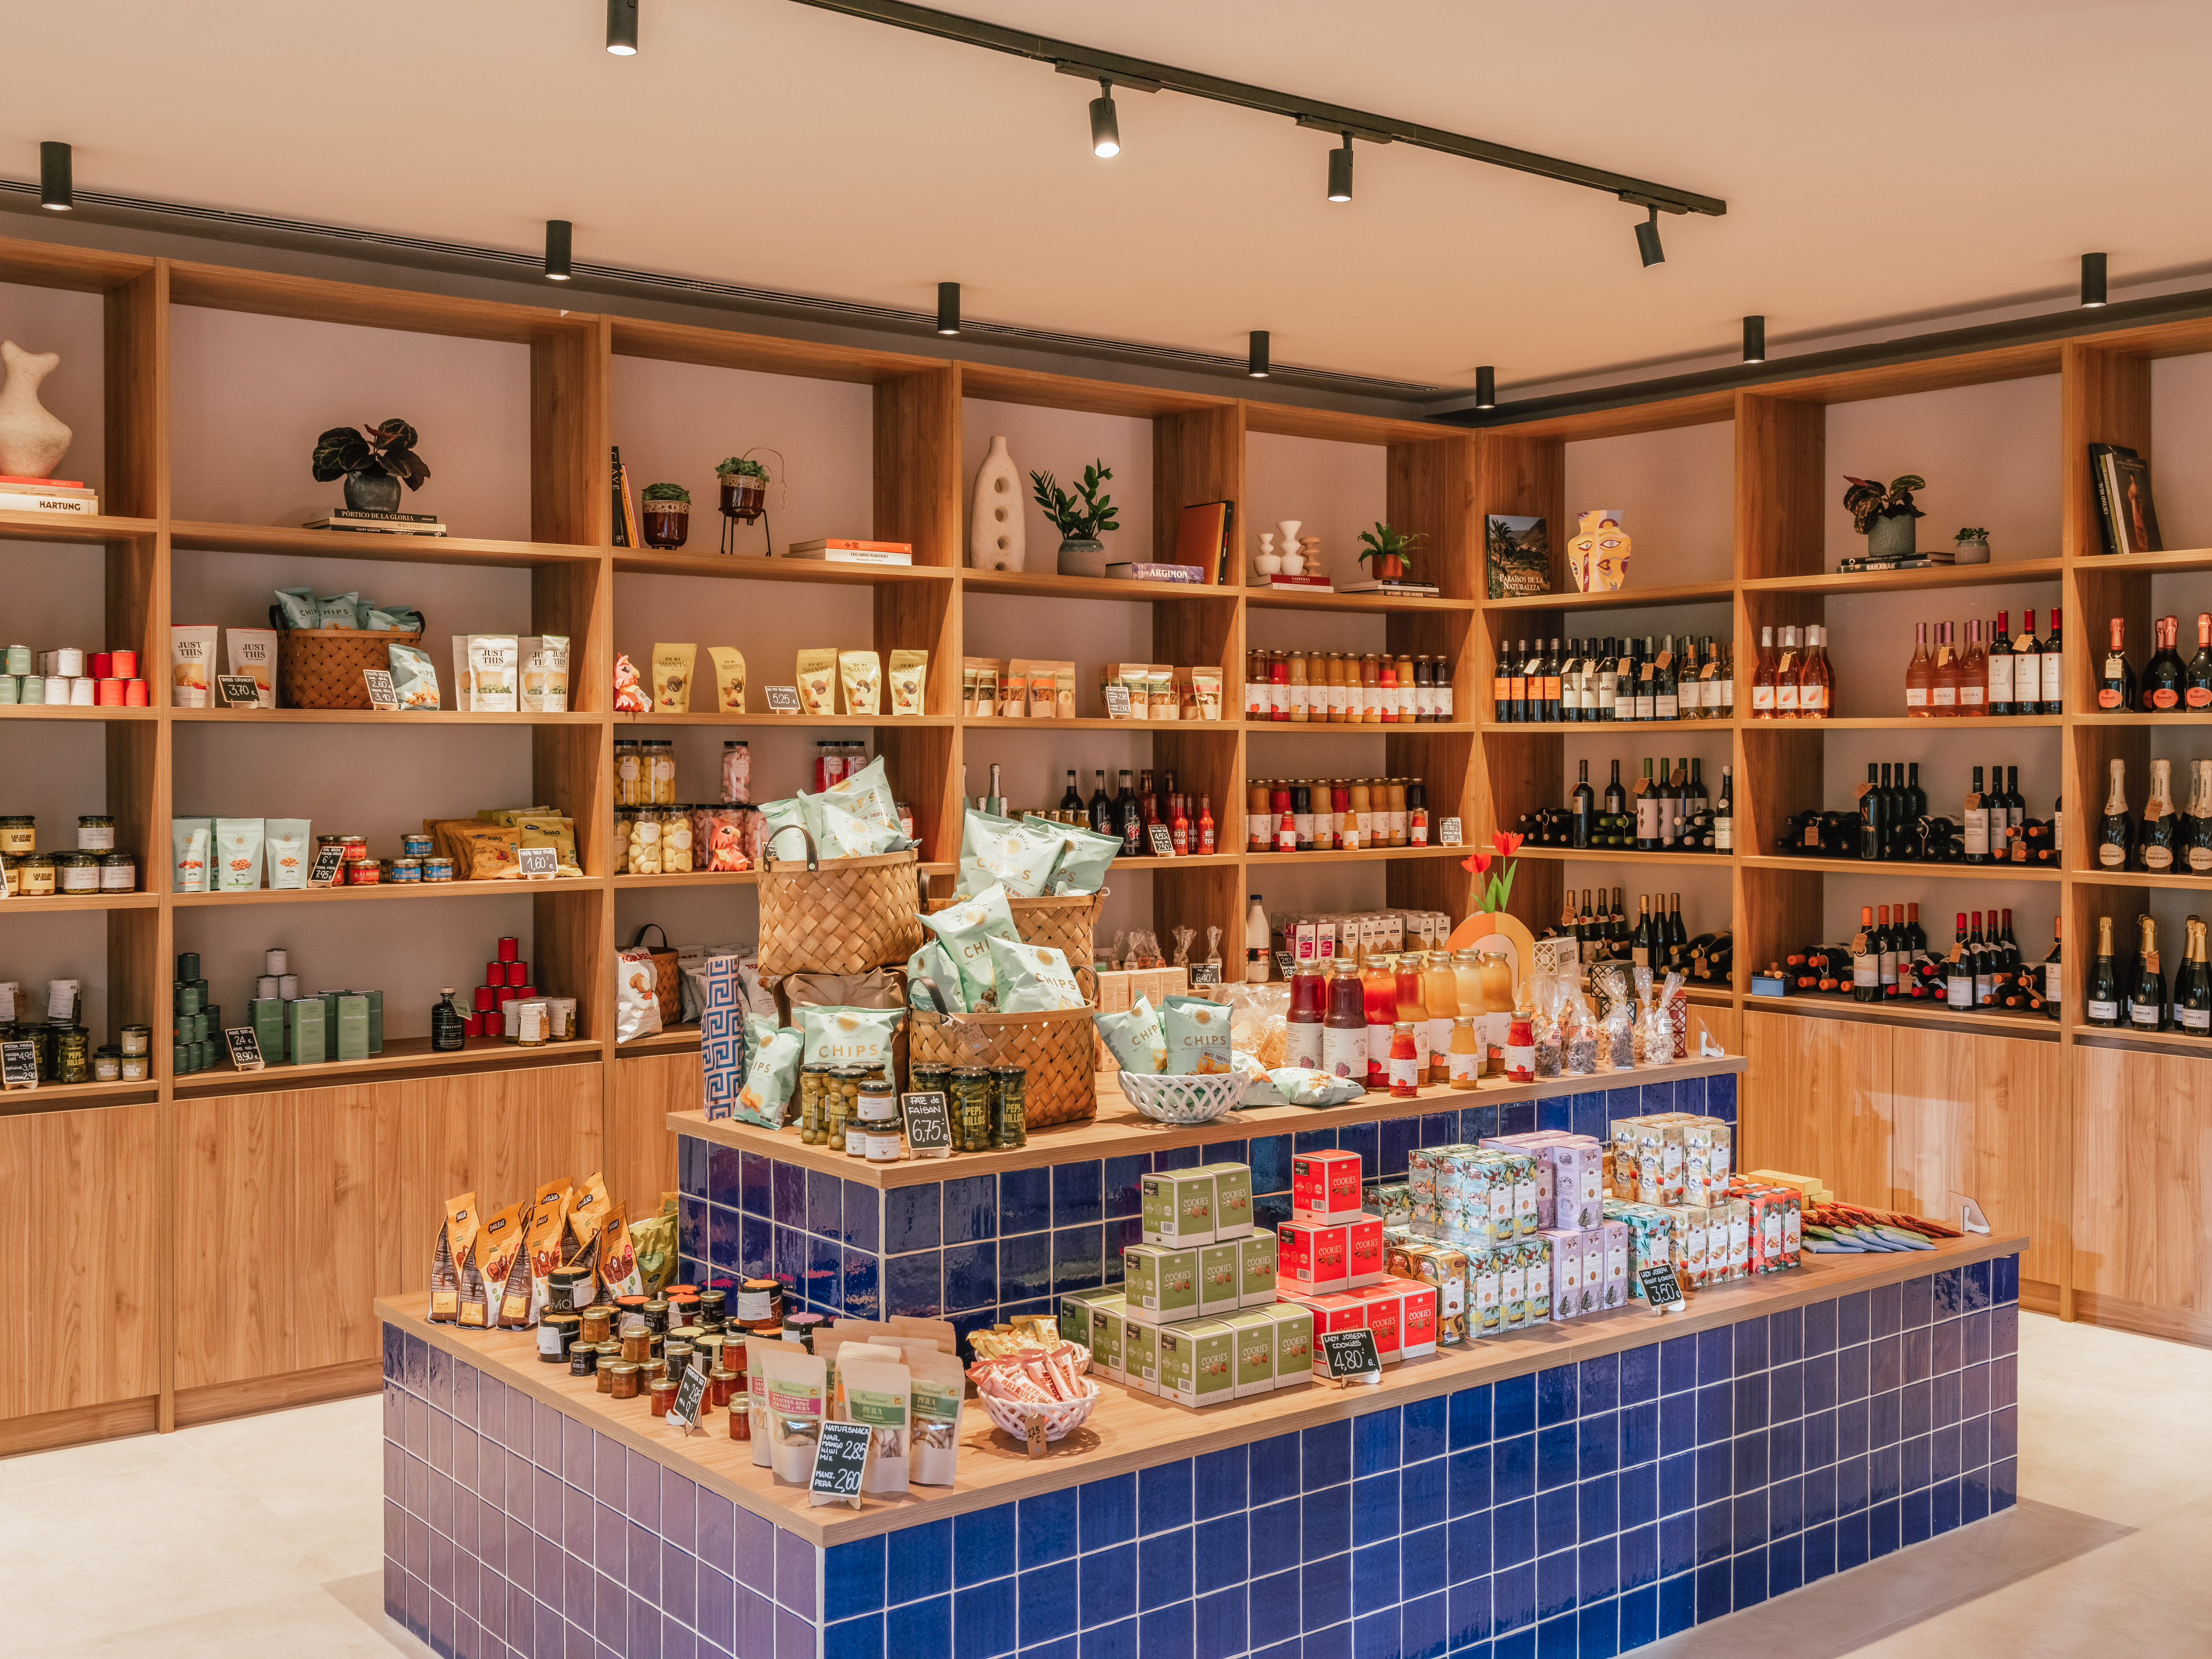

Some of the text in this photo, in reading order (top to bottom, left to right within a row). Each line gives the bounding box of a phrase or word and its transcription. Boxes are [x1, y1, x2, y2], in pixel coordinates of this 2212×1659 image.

[40, 501, 80, 511] HARTUNG
[342, 510, 370, 519] PÓRTICO
[1150, 569, 1188, 579] ARGIMON
[1500, 574, 1526, 583] PARAÍSOS
[1504, 582, 1540, 591] NATURALEZA
[228, 685, 249, 696] 3,70
[773, 693, 790, 705] 5,25
[527, 857, 546, 870] 1,60
[977, 857, 1031, 880] CHPS
[619, 953, 652, 963] TORRES
[1036, 973, 1076, 990] CHIPS
[1196, 974, 1211, 983] 6,40
[1061, 995, 1072, 1003] WHITE
[1132, 1022, 1161, 1046] CHIPS
[235, 1036, 246, 1045] 24
[1184, 1035, 1227, 1047] CHIPS
[236, 1052, 253, 1061] 8,90
[818, 1044, 878, 1058] CHIPS
[1216, 1055, 1230, 1063] TRUFFLE
[931, 1096, 940, 1104] de
[966, 1106, 983, 1116] PEPI-
[1006, 1103, 1022, 1113] PEPI-
[963, 1115, 985, 1126] NILLOS
[1004, 1113, 1024, 1123] NILLOS
[913, 1119, 941, 1143] 6,75
[1333, 1175, 1357, 1186] COOKIES
[542, 1194, 559, 1203] SMILEAT
[1222, 1188, 1246, 1200] COOKIES
[577, 1196, 593, 1209] SMILEAT
[1183, 1197, 1209, 1209] COOKIES
[456, 1211, 467, 1220] SMILEAT
[537, 1216, 548, 1225] SMILEAT
[489, 1220, 506, 1232] SMILEAT
[608, 1221, 619, 1233] SMILEAT
[1355, 1239, 1378, 1249] COOKIES
[1318, 1245, 1342, 1256] COOKIES
[1247, 1255, 1271, 1268] COOKIES
[1207, 1263, 1233, 1276] COOKIES
[1640, 1270, 1651, 1278] LADY
[1165, 1270, 1191, 1283] COOKIES
[1650, 1283, 1675, 1304] 3,50
[1408, 1308, 1431, 1320] COOKIES
[1372, 1316, 1396, 1327] COOKIES
[1283, 1335, 1308, 1348] COOKIES
[1243, 1343, 1269, 1357] COOKIES
[1201, 1352, 1228, 1365] COOKIES
[1334, 1350, 1363, 1371] 4,80
[773, 1401, 791, 1409] NARANJA
[917, 1396, 936, 1405] PERA
[863, 1406, 883, 1415] PERA
[825, 1424, 869, 1436] NATURSNACK
[1027, 1425, 1041, 1440] 2,25
[822, 1441, 844, 1449] MANGO
[842, 1440, 866, 1461] 2,85
[815, 1470, 835, 1479] MANZ.
[814, 1479, 832, 1488] PERA
[834, 1469, 860, 1493] 2,60
